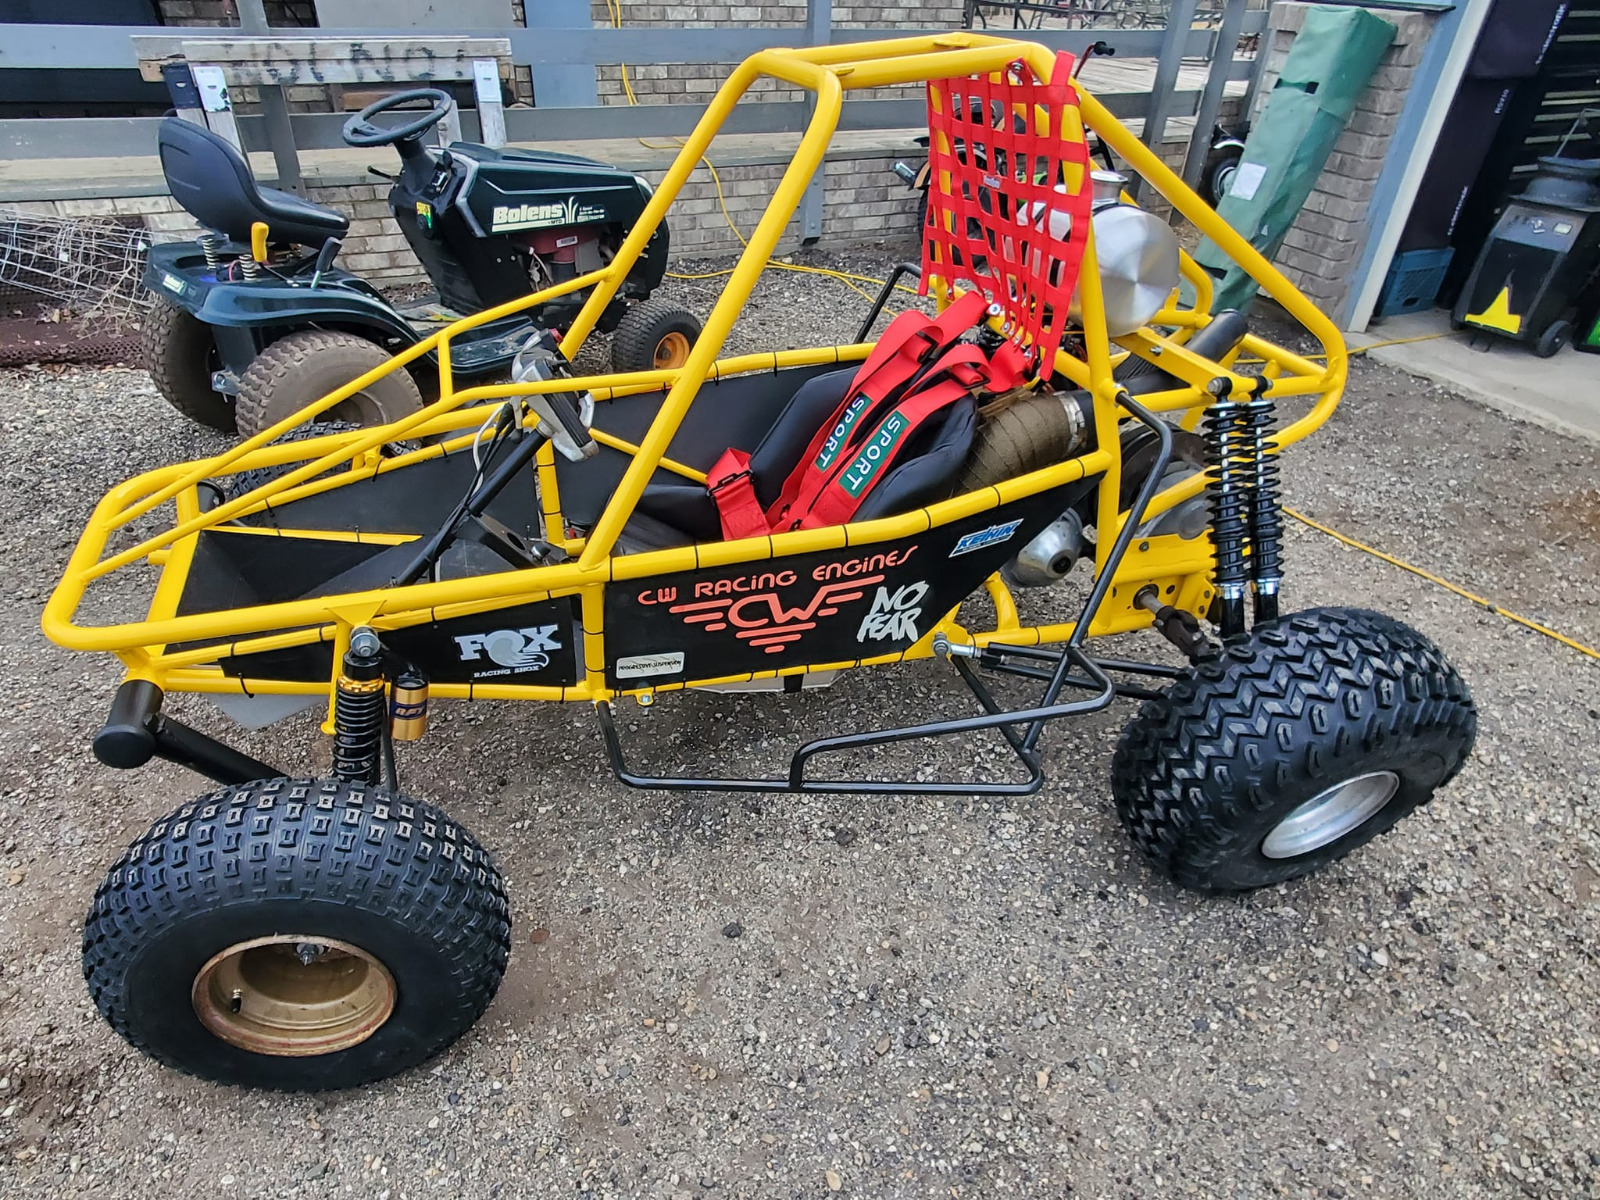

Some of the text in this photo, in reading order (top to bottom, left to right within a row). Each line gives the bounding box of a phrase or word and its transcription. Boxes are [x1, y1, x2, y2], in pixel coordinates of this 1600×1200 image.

[492, 203, 563, 225] Bolens
[819, 396, 865, 468] SPORT
[846, 415, 901, 491] SPORT
[637, 586, 677, 605] CW
[694, 570, 798, 598] RACING
[869, 580, 930, 617] NO
[856, 607, 922, 643] FEAR
[453, 624, 562, 667] FOX
[473, 664, 540, 678] RACING SHOX
